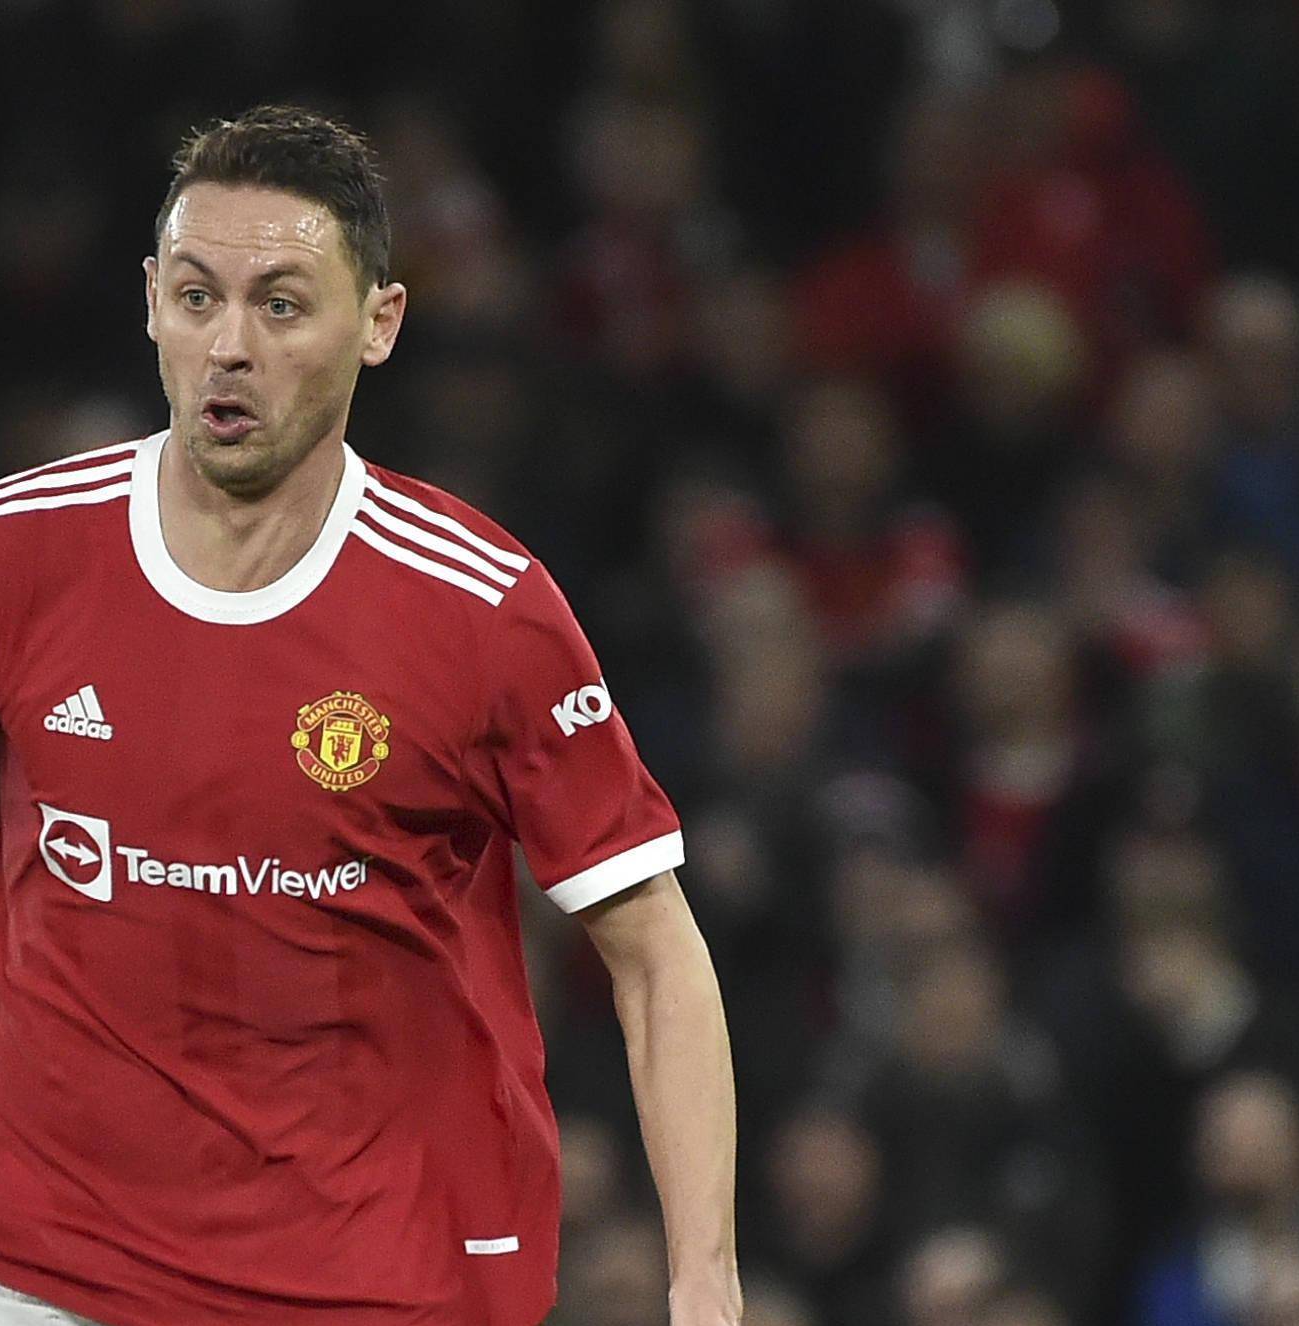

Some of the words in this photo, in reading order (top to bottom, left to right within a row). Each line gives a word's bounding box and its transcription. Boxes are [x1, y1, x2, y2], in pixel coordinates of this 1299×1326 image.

[43, 712, 113, 741] adidas
[304, 697, 383, 737] MANCHESTER
[550, 676, 612, 737] KO
[310, 765, 366, 786] UNITED
[116, 845, 370, 900] TeamViewer
